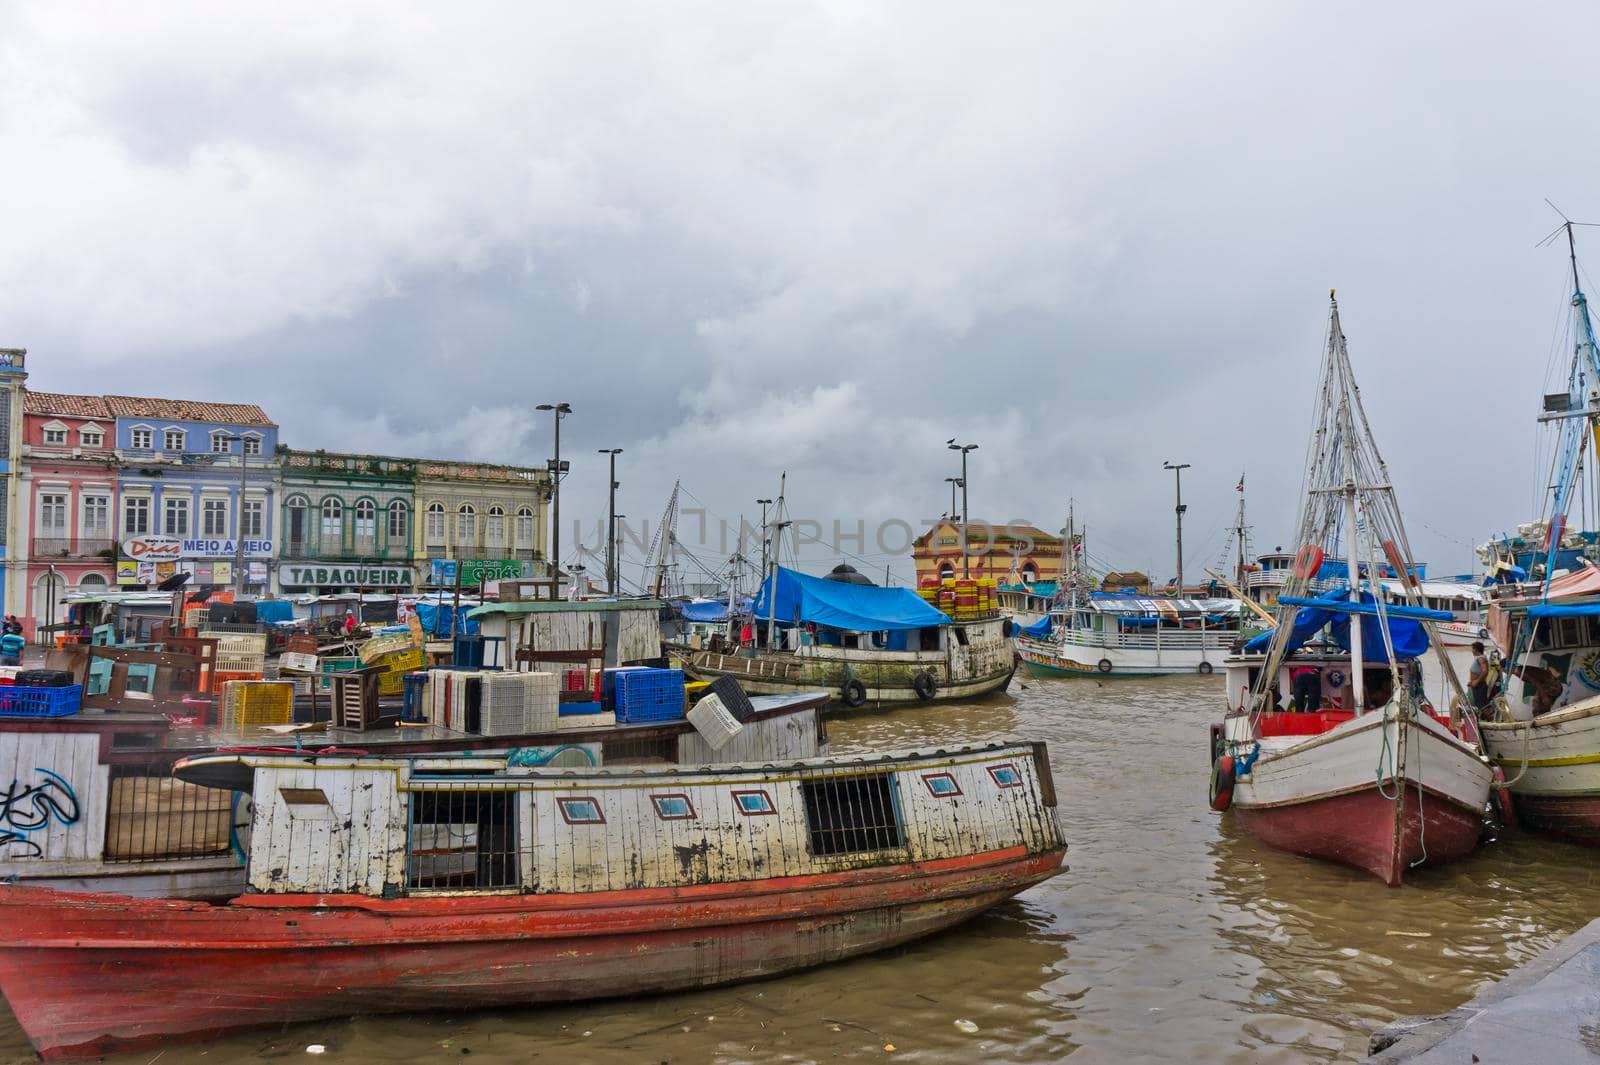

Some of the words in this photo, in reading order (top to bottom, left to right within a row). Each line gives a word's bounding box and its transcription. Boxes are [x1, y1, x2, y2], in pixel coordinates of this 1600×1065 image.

[131, 541, 180, 556] Dias
[184, 540, 219, 551] MEIO
[224, 541, 233, 551] A
[290, 568, 411, 584] TABAQUEIRA
